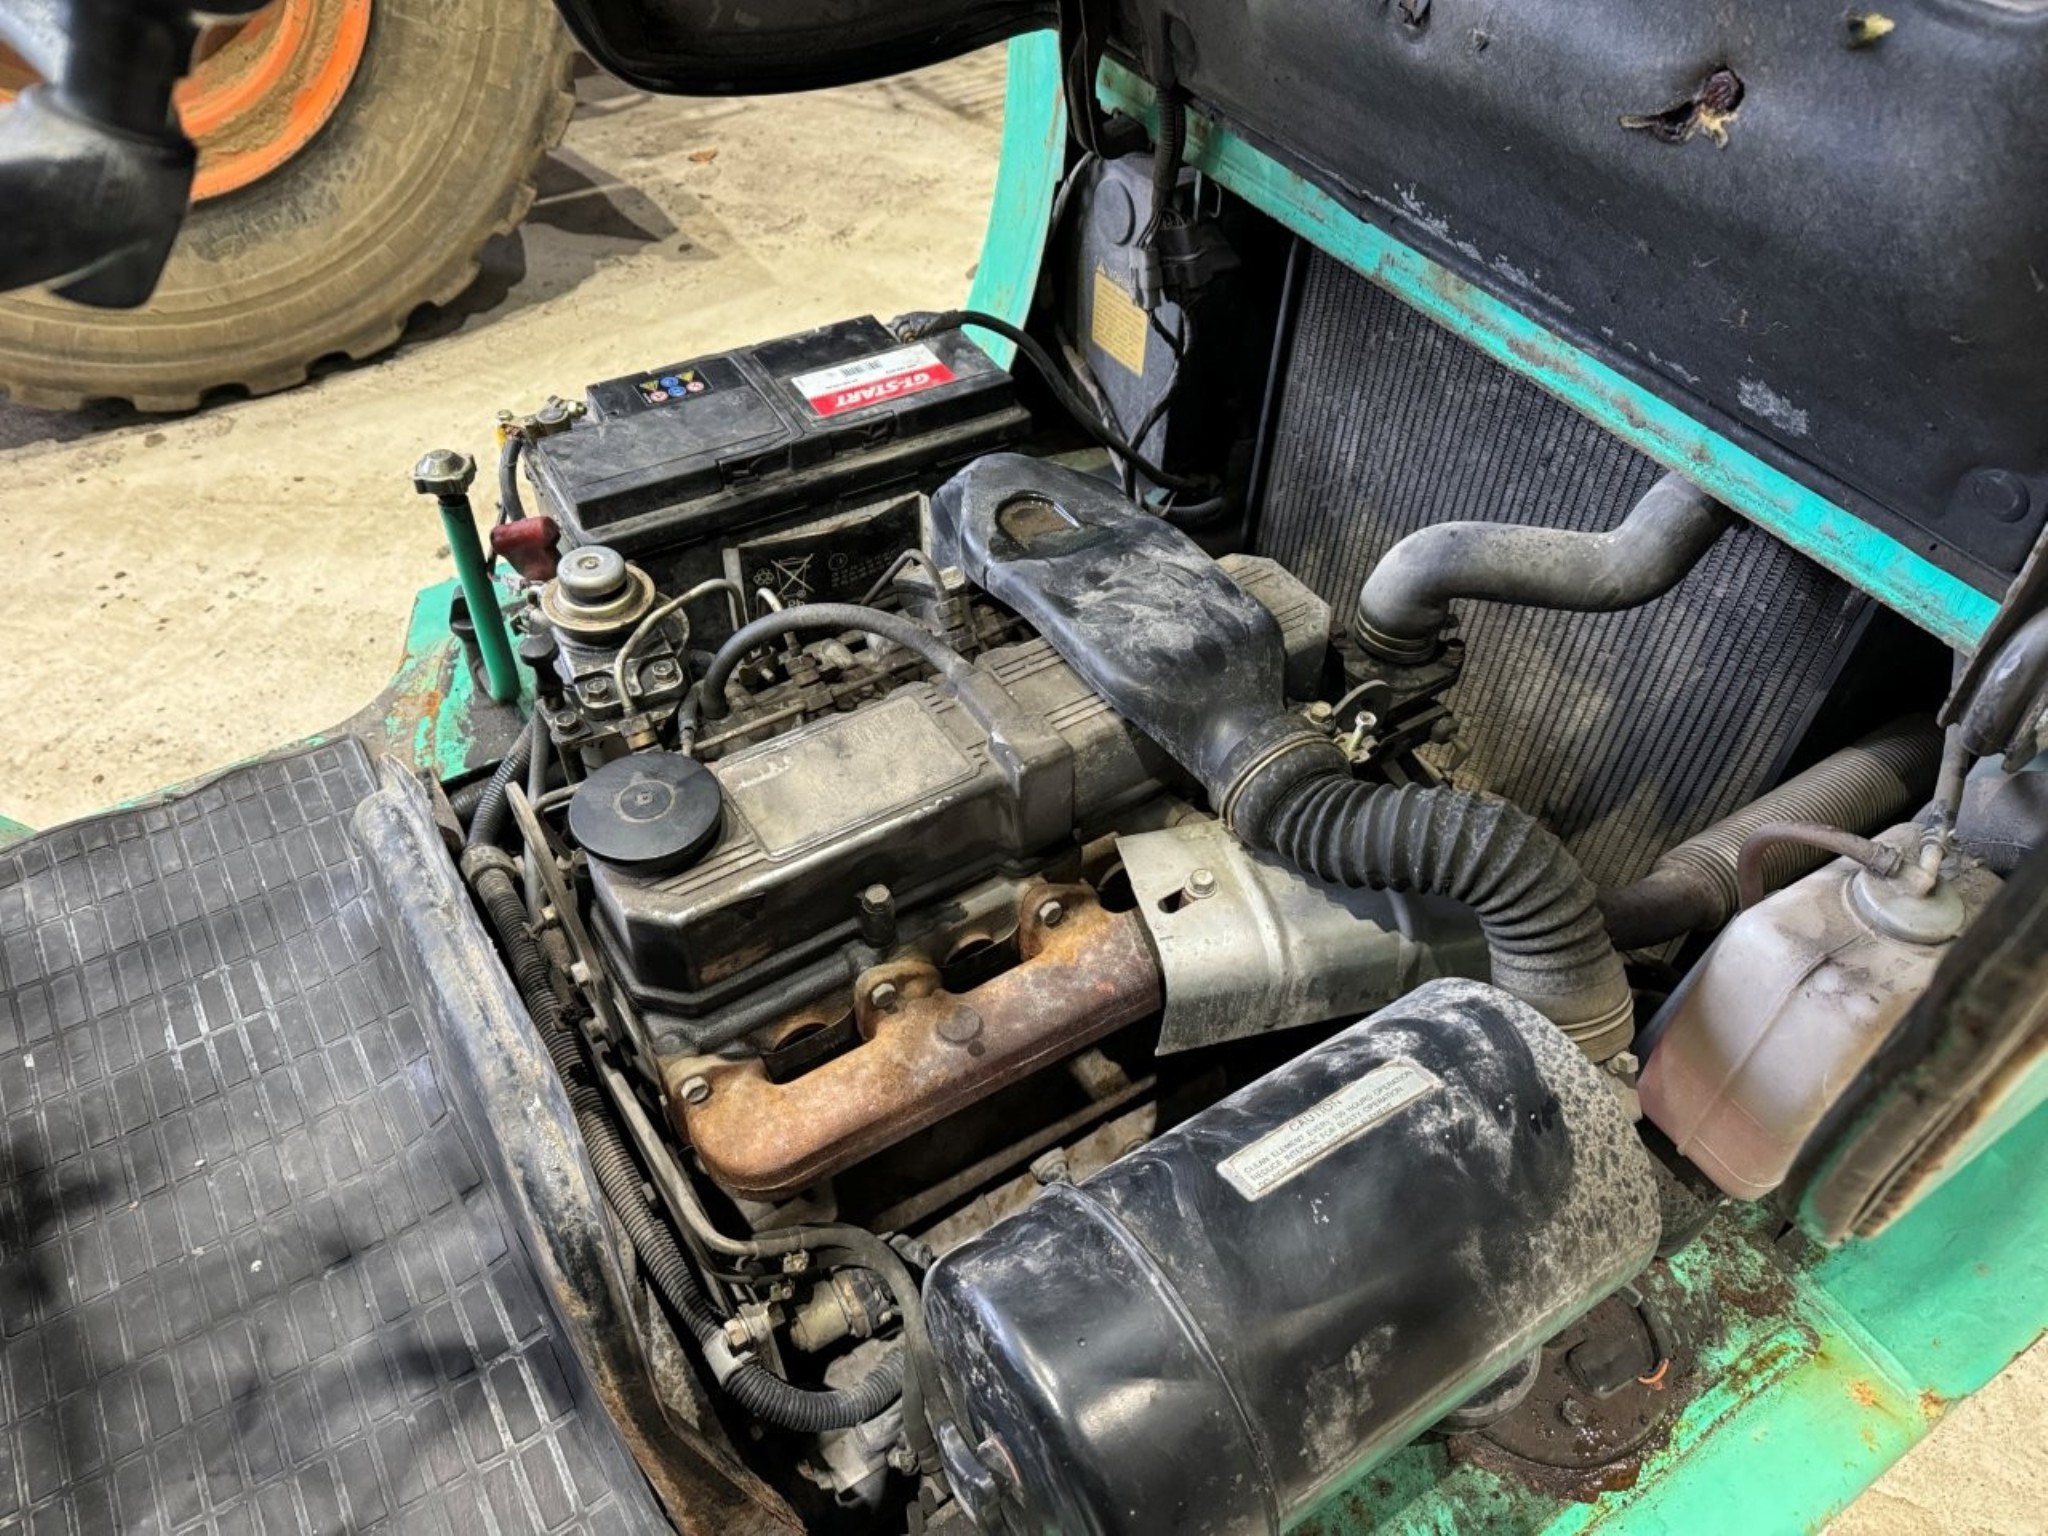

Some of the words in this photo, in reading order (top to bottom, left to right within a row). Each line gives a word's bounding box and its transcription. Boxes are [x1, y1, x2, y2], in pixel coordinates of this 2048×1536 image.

[834, 372, 930, 407] GT-START
[1286, 1096, 1343, 1132] CAUTION
[1360, 1085, 1404, 1113] OPERATION
